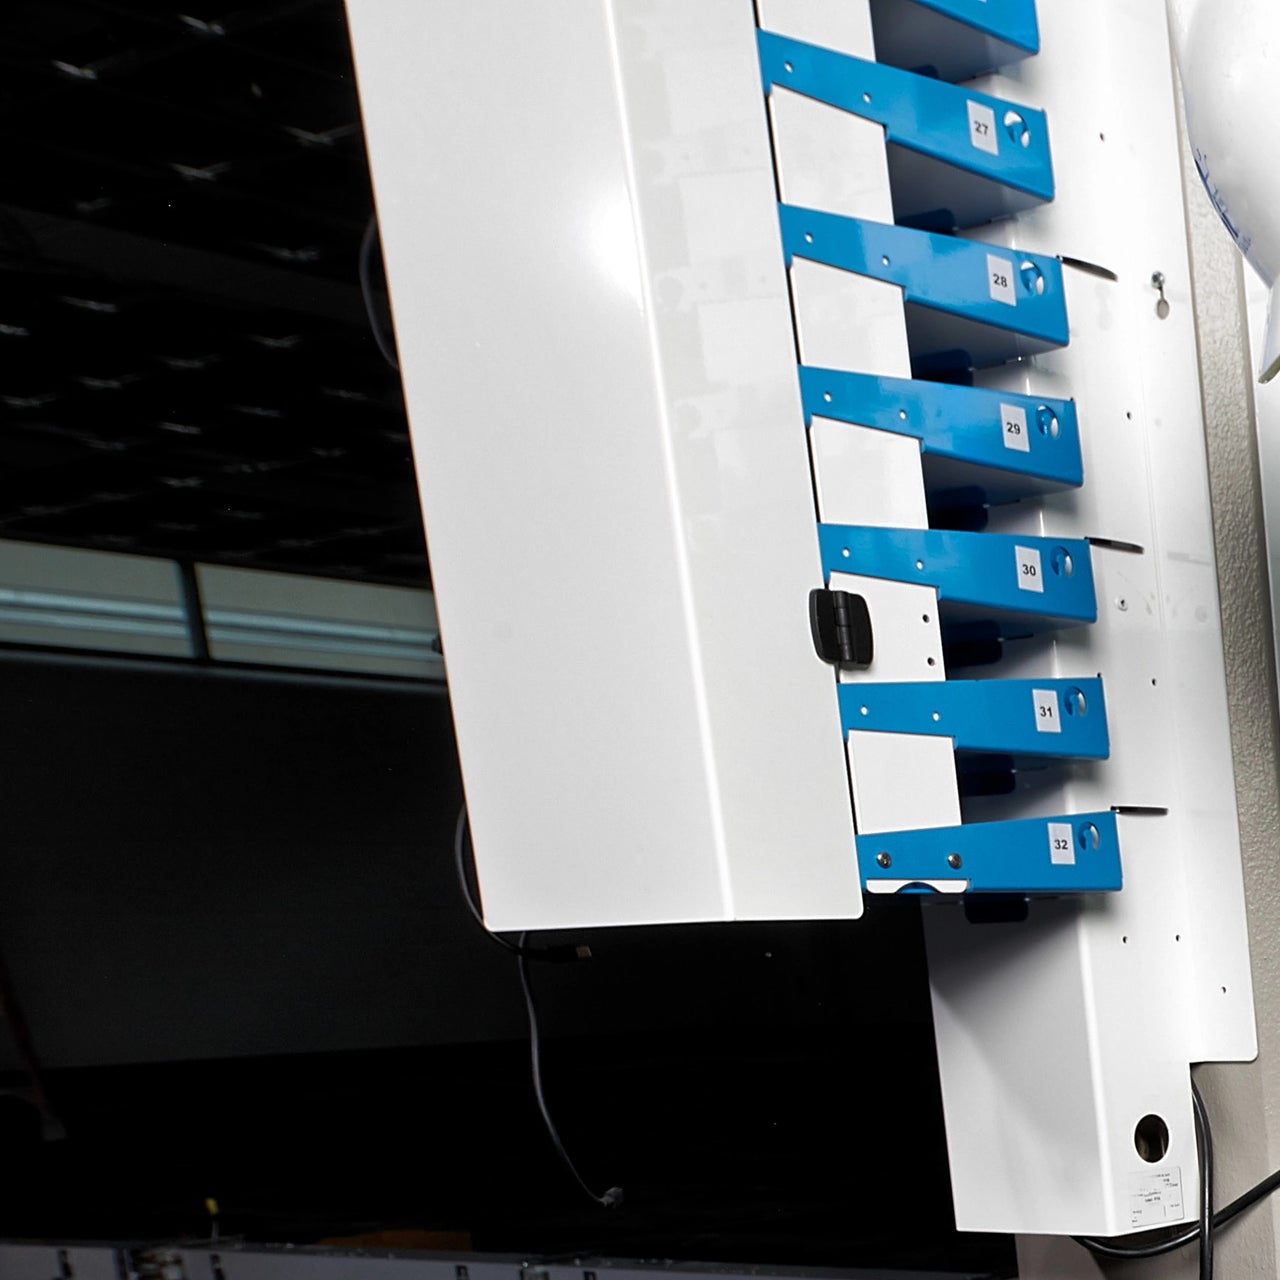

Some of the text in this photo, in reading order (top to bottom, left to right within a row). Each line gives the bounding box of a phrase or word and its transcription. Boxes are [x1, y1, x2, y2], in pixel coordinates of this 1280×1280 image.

[974, 121, 990, 136] 27
[992, 274, 1009, 289] 28
[1005, 421, 1022, 436] 29
[1021, 563, 1037, 578] 30
[1039, 706, 1053, 718] 31
[1053, 838, 1069, 851] 32
